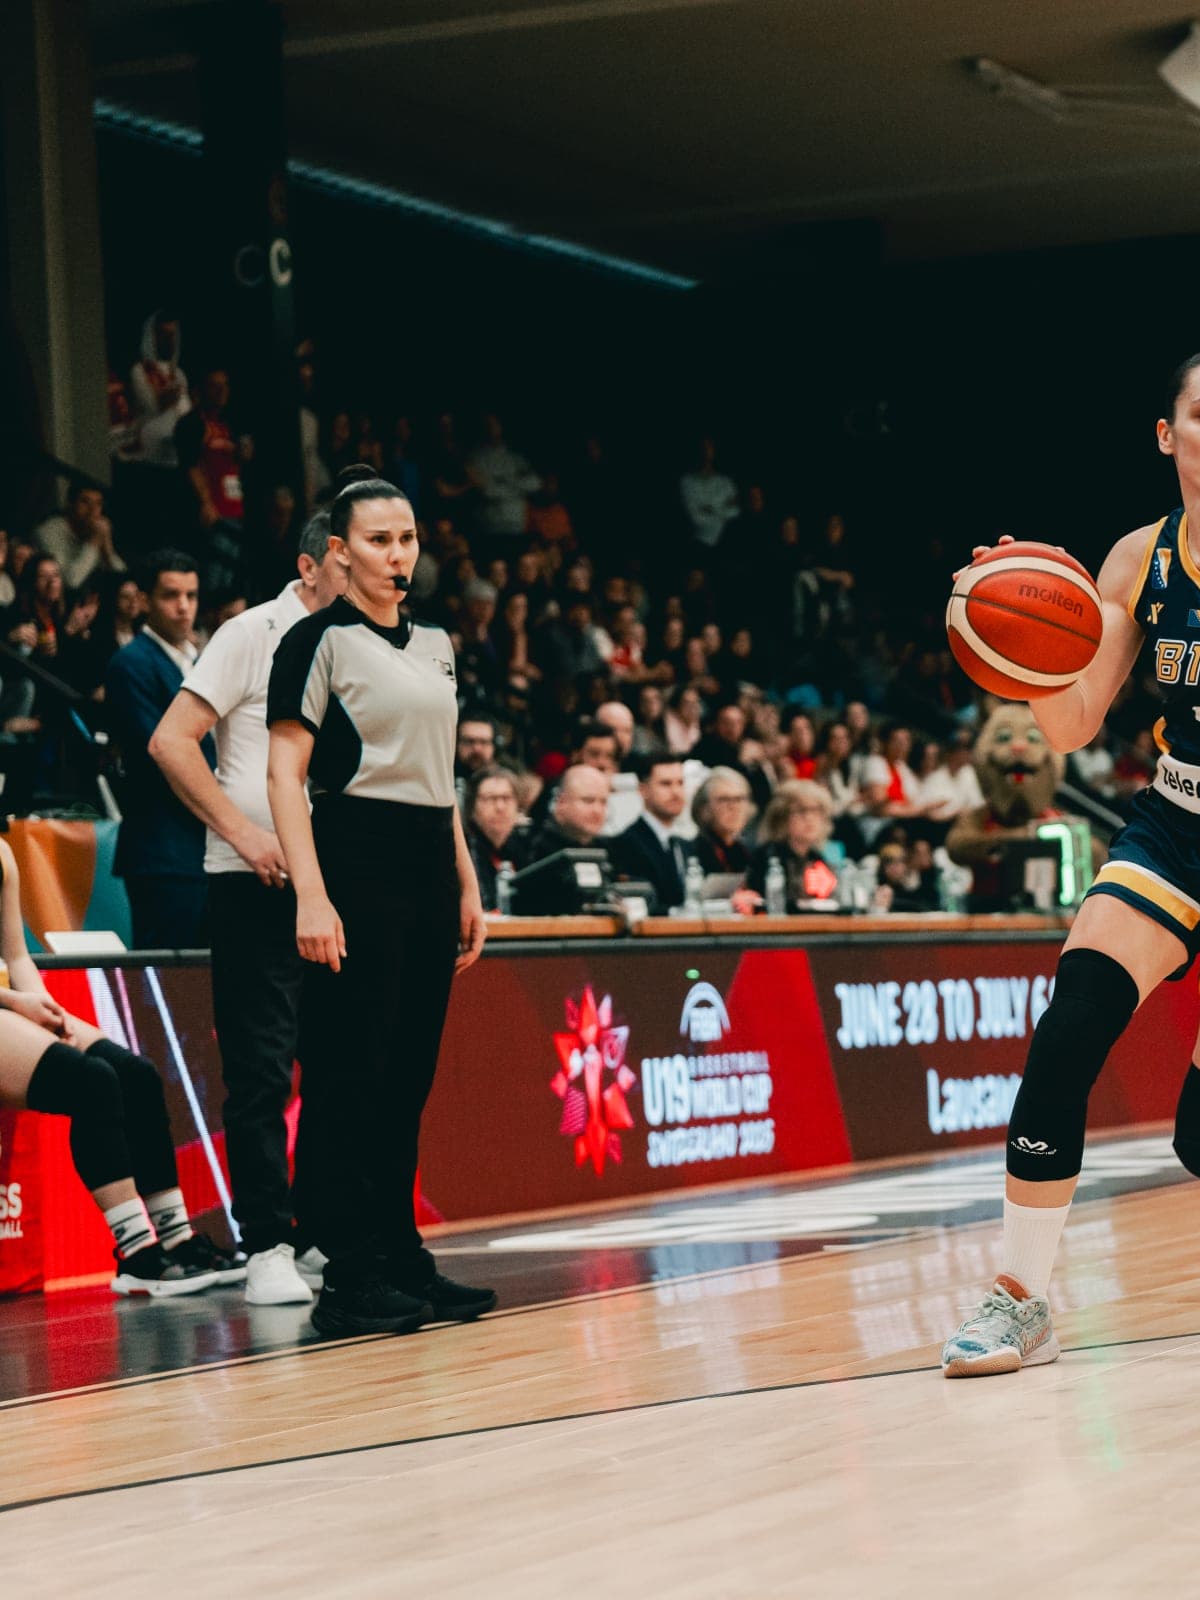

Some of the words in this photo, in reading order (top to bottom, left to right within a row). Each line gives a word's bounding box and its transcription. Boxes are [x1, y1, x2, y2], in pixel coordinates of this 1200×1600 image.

[1018, 584, 1084, 617] molten
[835, 980, 903, 1049] JUNE
[902, 978, 939, 1045] 28
[938, 977, 975, 1041] TO
[974, 975, 1029, 1038] JULY
[641, 1053, 691, 1127] U19
